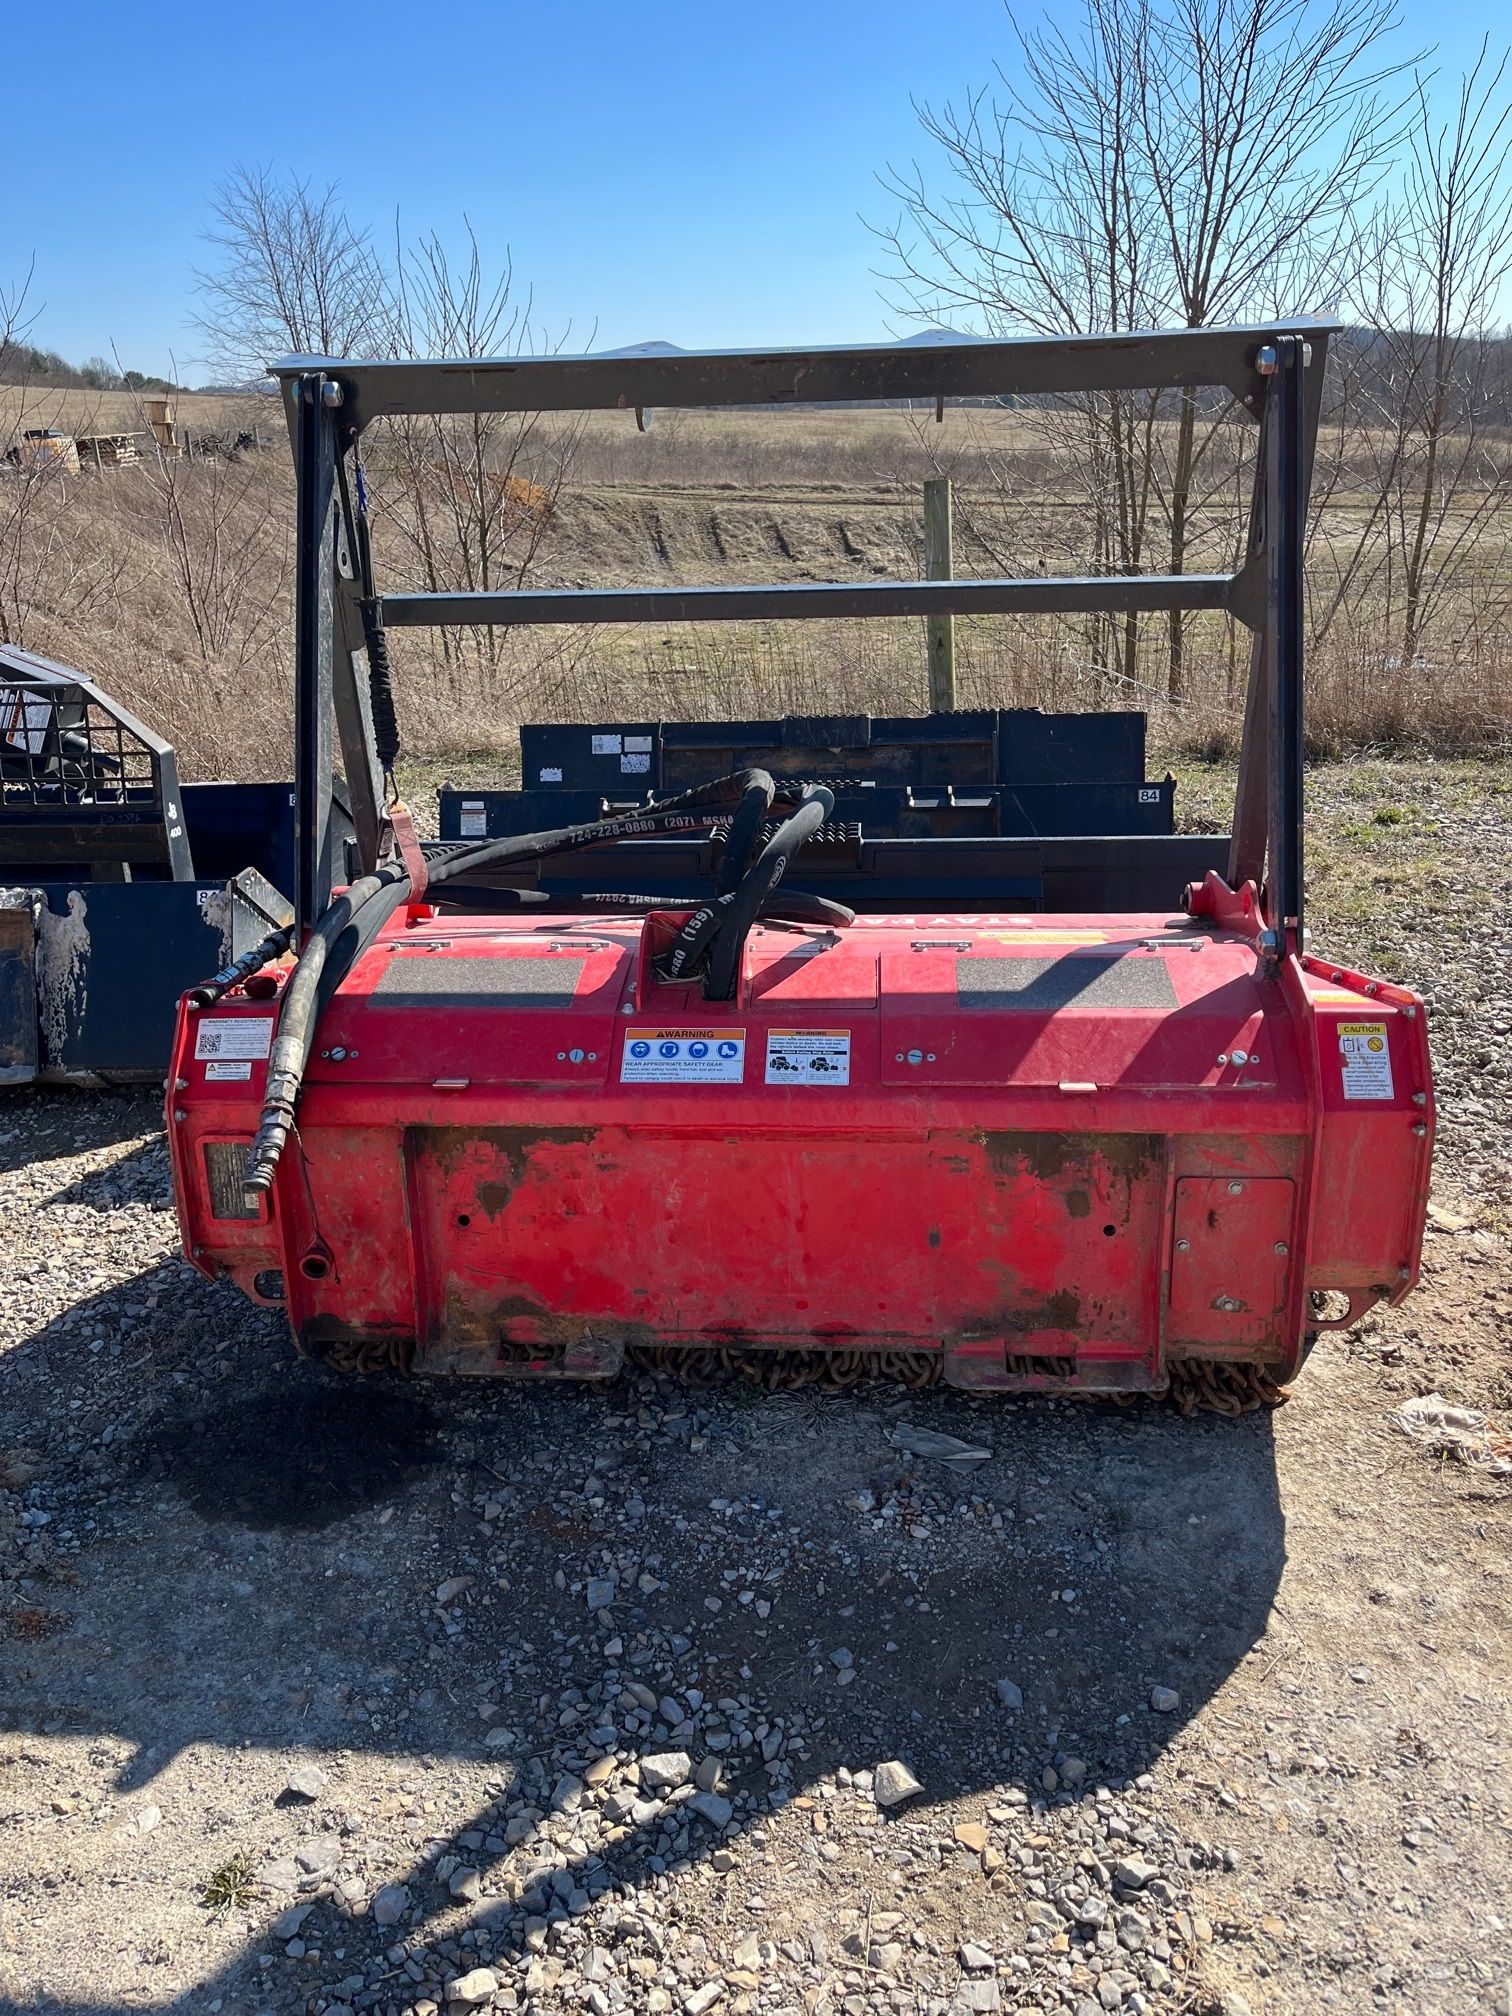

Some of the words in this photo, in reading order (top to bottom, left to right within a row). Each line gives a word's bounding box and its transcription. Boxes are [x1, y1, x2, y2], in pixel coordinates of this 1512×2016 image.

[1141, 790, 1158, 801] 84
[170, 826, 182, 838] 400
[569, 819, 656, 843] 724-228-0880
[664, 815, 695, 828] (207)
[681, 908, 714, 941] (159)
